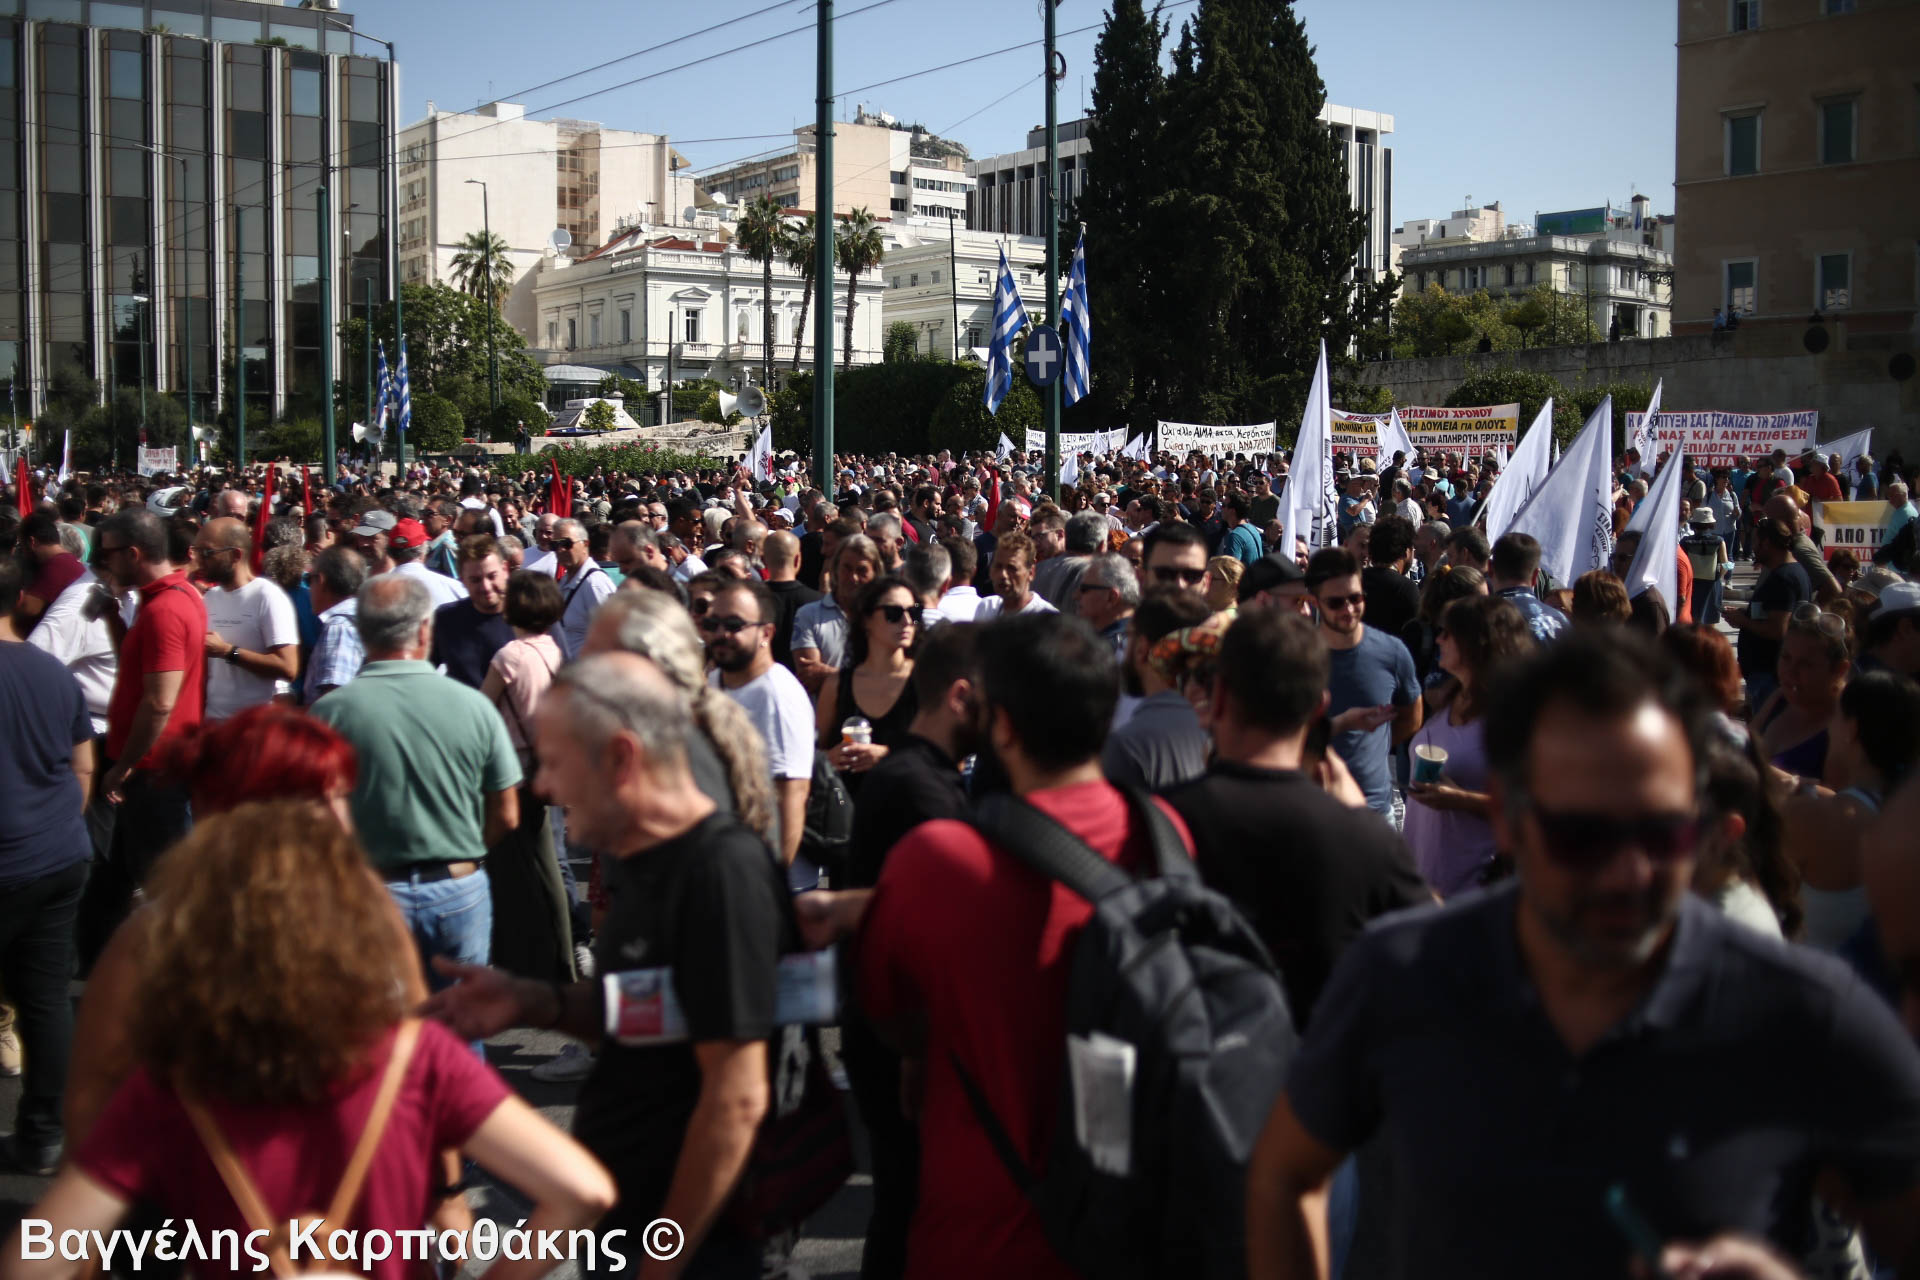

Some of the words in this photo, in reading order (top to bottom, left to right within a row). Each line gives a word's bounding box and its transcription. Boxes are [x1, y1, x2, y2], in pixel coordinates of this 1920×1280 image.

[1398, 408, 1449, 418] ΕΡΓΑΣΙΜΟΥ
[1452, 407, 1493, 418] ΧΡΟΝΟΥ
[1421, 421, 1458, 431] ΔΟΥΛΕΙΑ
[1475, 420, 1507, 430] ΟΛΟΥΣ
[1628, 414, 1635, 428] Η
[1636, 413, 1688, 428] ΑΠΤΥΞΗ
[1690, 413, 1709, 428] ΣΑΣ
[1711, 413, 1754, 428] ΤΣΑΚΙΖΕΙ
[1756, 415, 1769, 428] ΤΗ
[1770, 415, 1790, 428] ΖΩΗ
[1792, 412, 1814, 427] ΜΑΣ
[1692, 430, 1715, 440] ΚΑΙ
[1720, 429, 1808, 441] ΑΝΤΕΠΙΘΕΣΗ
[1665, 443, 1674, 453] Η
[1683, 443, 1736, 453] ΕΠΙΛΟΓΗ
[1741, 443, 1773, 454] ΜΑΣ
[1711, 456, 1735, 466] ΟΤΑ
[1834, 528, 1865, 543] ΑΠΟ
